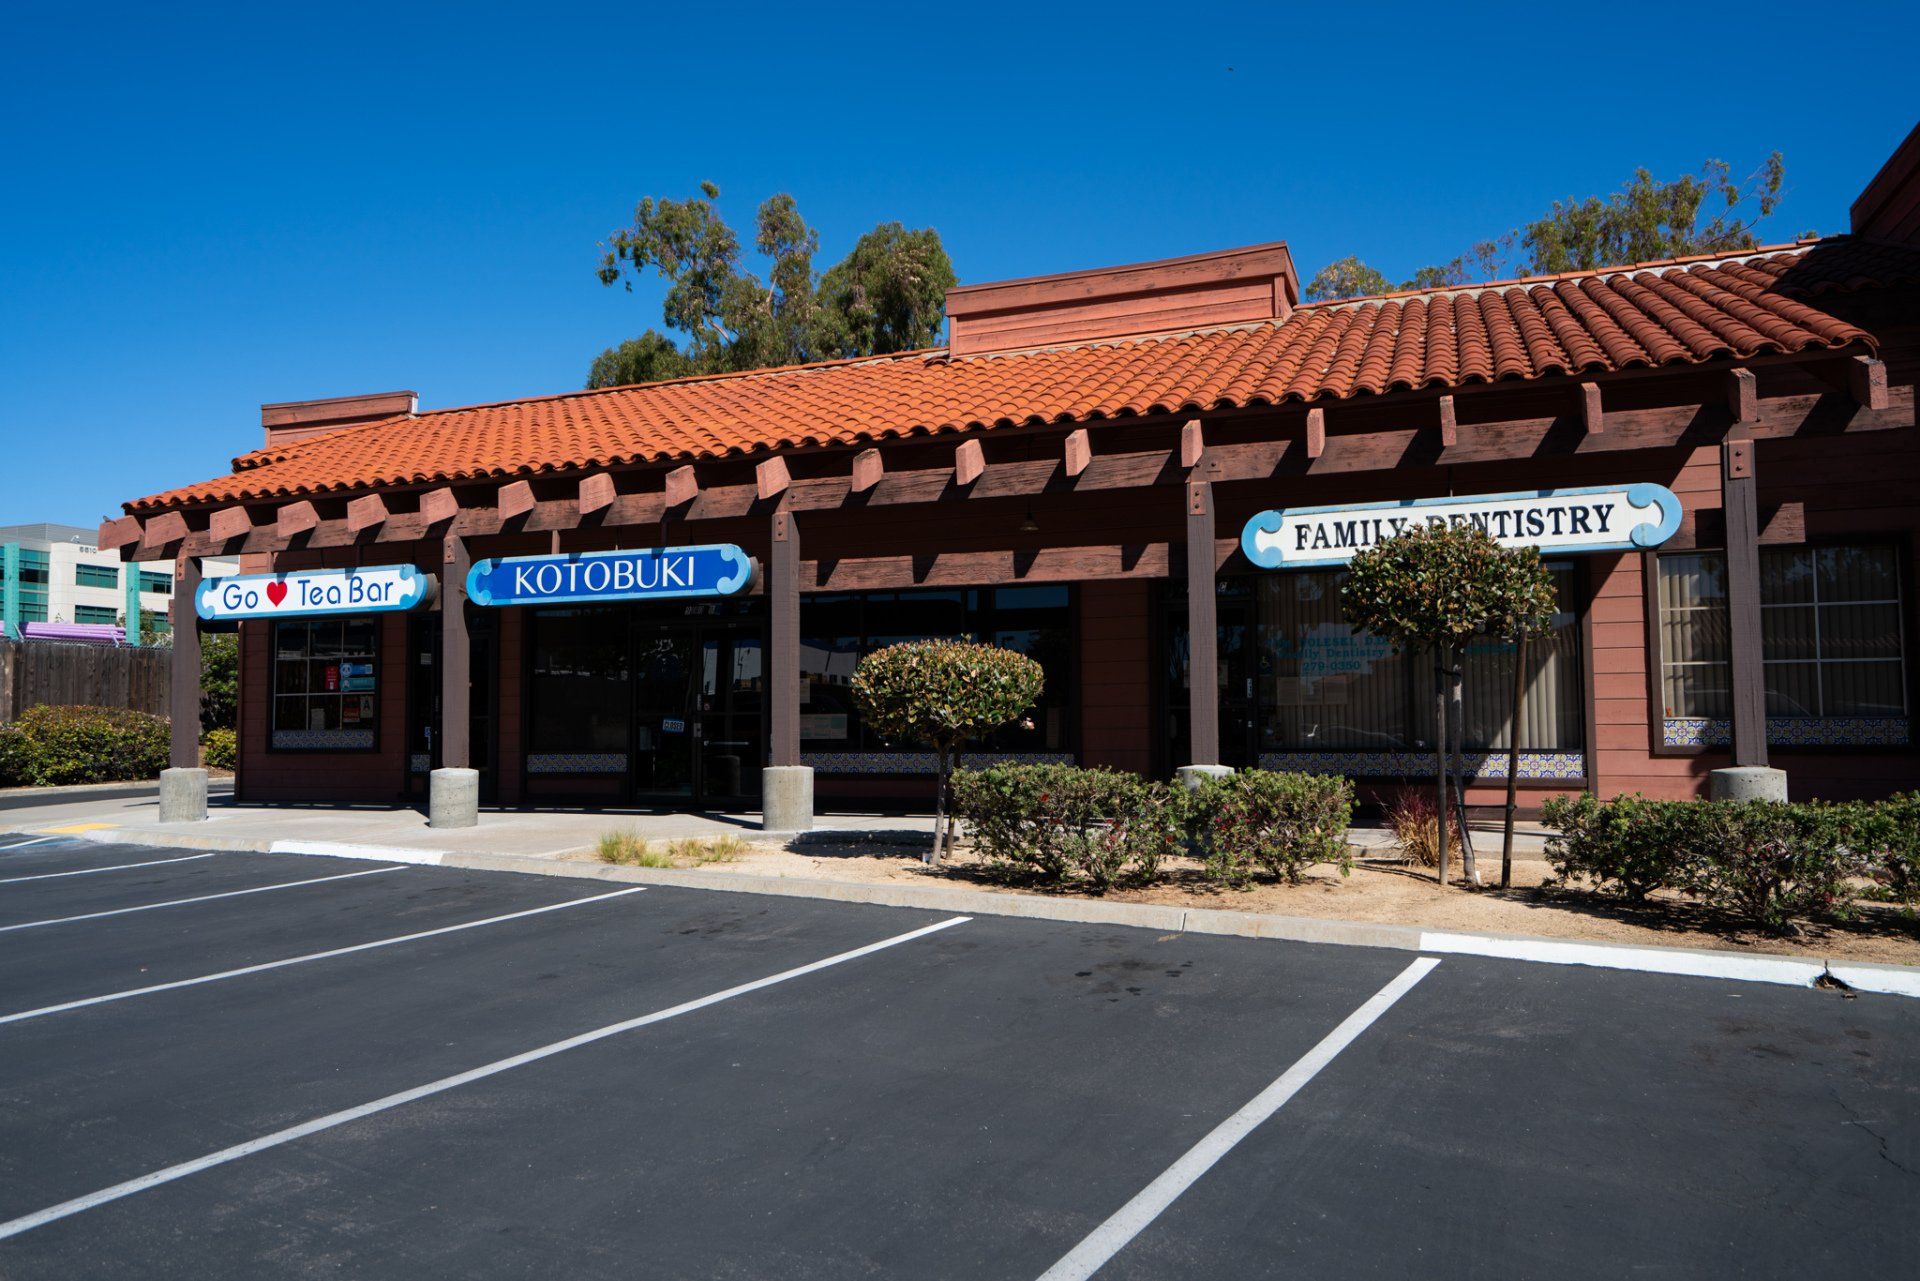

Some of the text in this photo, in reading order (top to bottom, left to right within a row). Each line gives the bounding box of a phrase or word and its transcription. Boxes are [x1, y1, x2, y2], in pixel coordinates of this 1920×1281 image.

[1294, 517, 1408, 551] FAMILY
[514, 556, 695, 595] KOTOBUKI
[222, 576, 394, 611] Go Tea Bar
